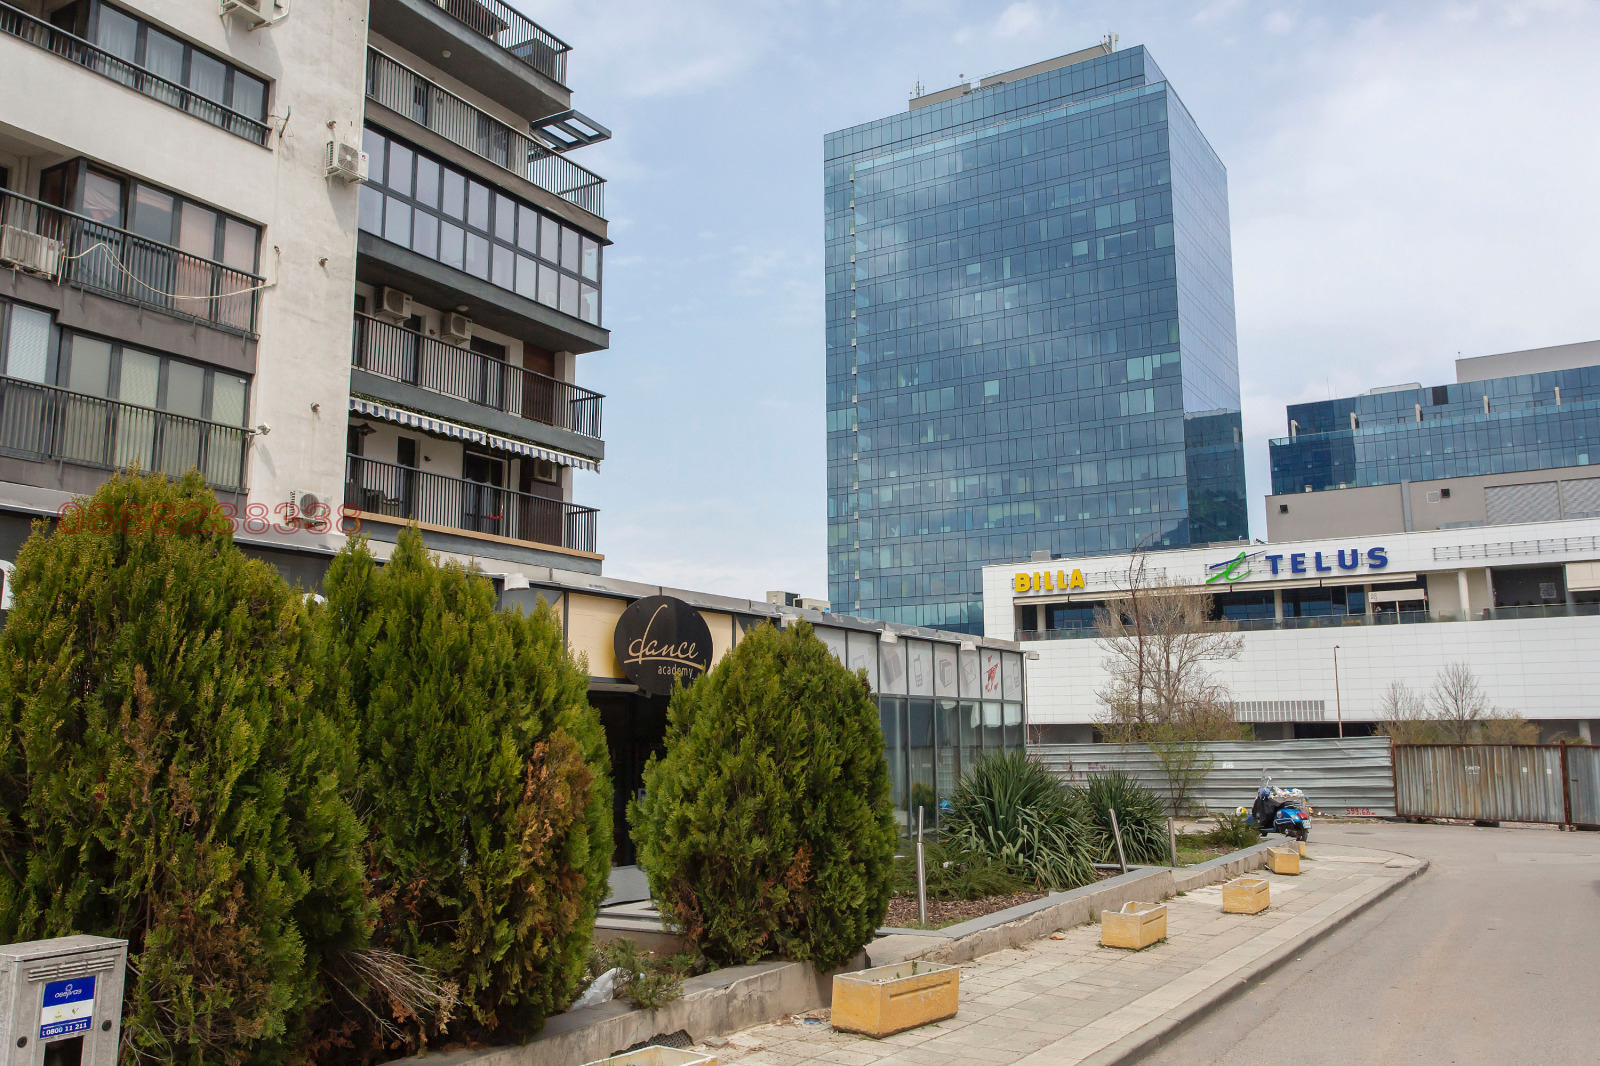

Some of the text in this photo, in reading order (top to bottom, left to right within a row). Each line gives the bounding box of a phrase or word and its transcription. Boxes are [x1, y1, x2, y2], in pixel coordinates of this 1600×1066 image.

[1265, 547, 1389, 575] TELUS
[1014, 569, 1085, 592] BILLA
[628, 604, 699, 665] dance
[657, 663, 694, 679] academy
[46, 1026, 63, 1035] 0800
[75, 1022, 87, 1030] 211
